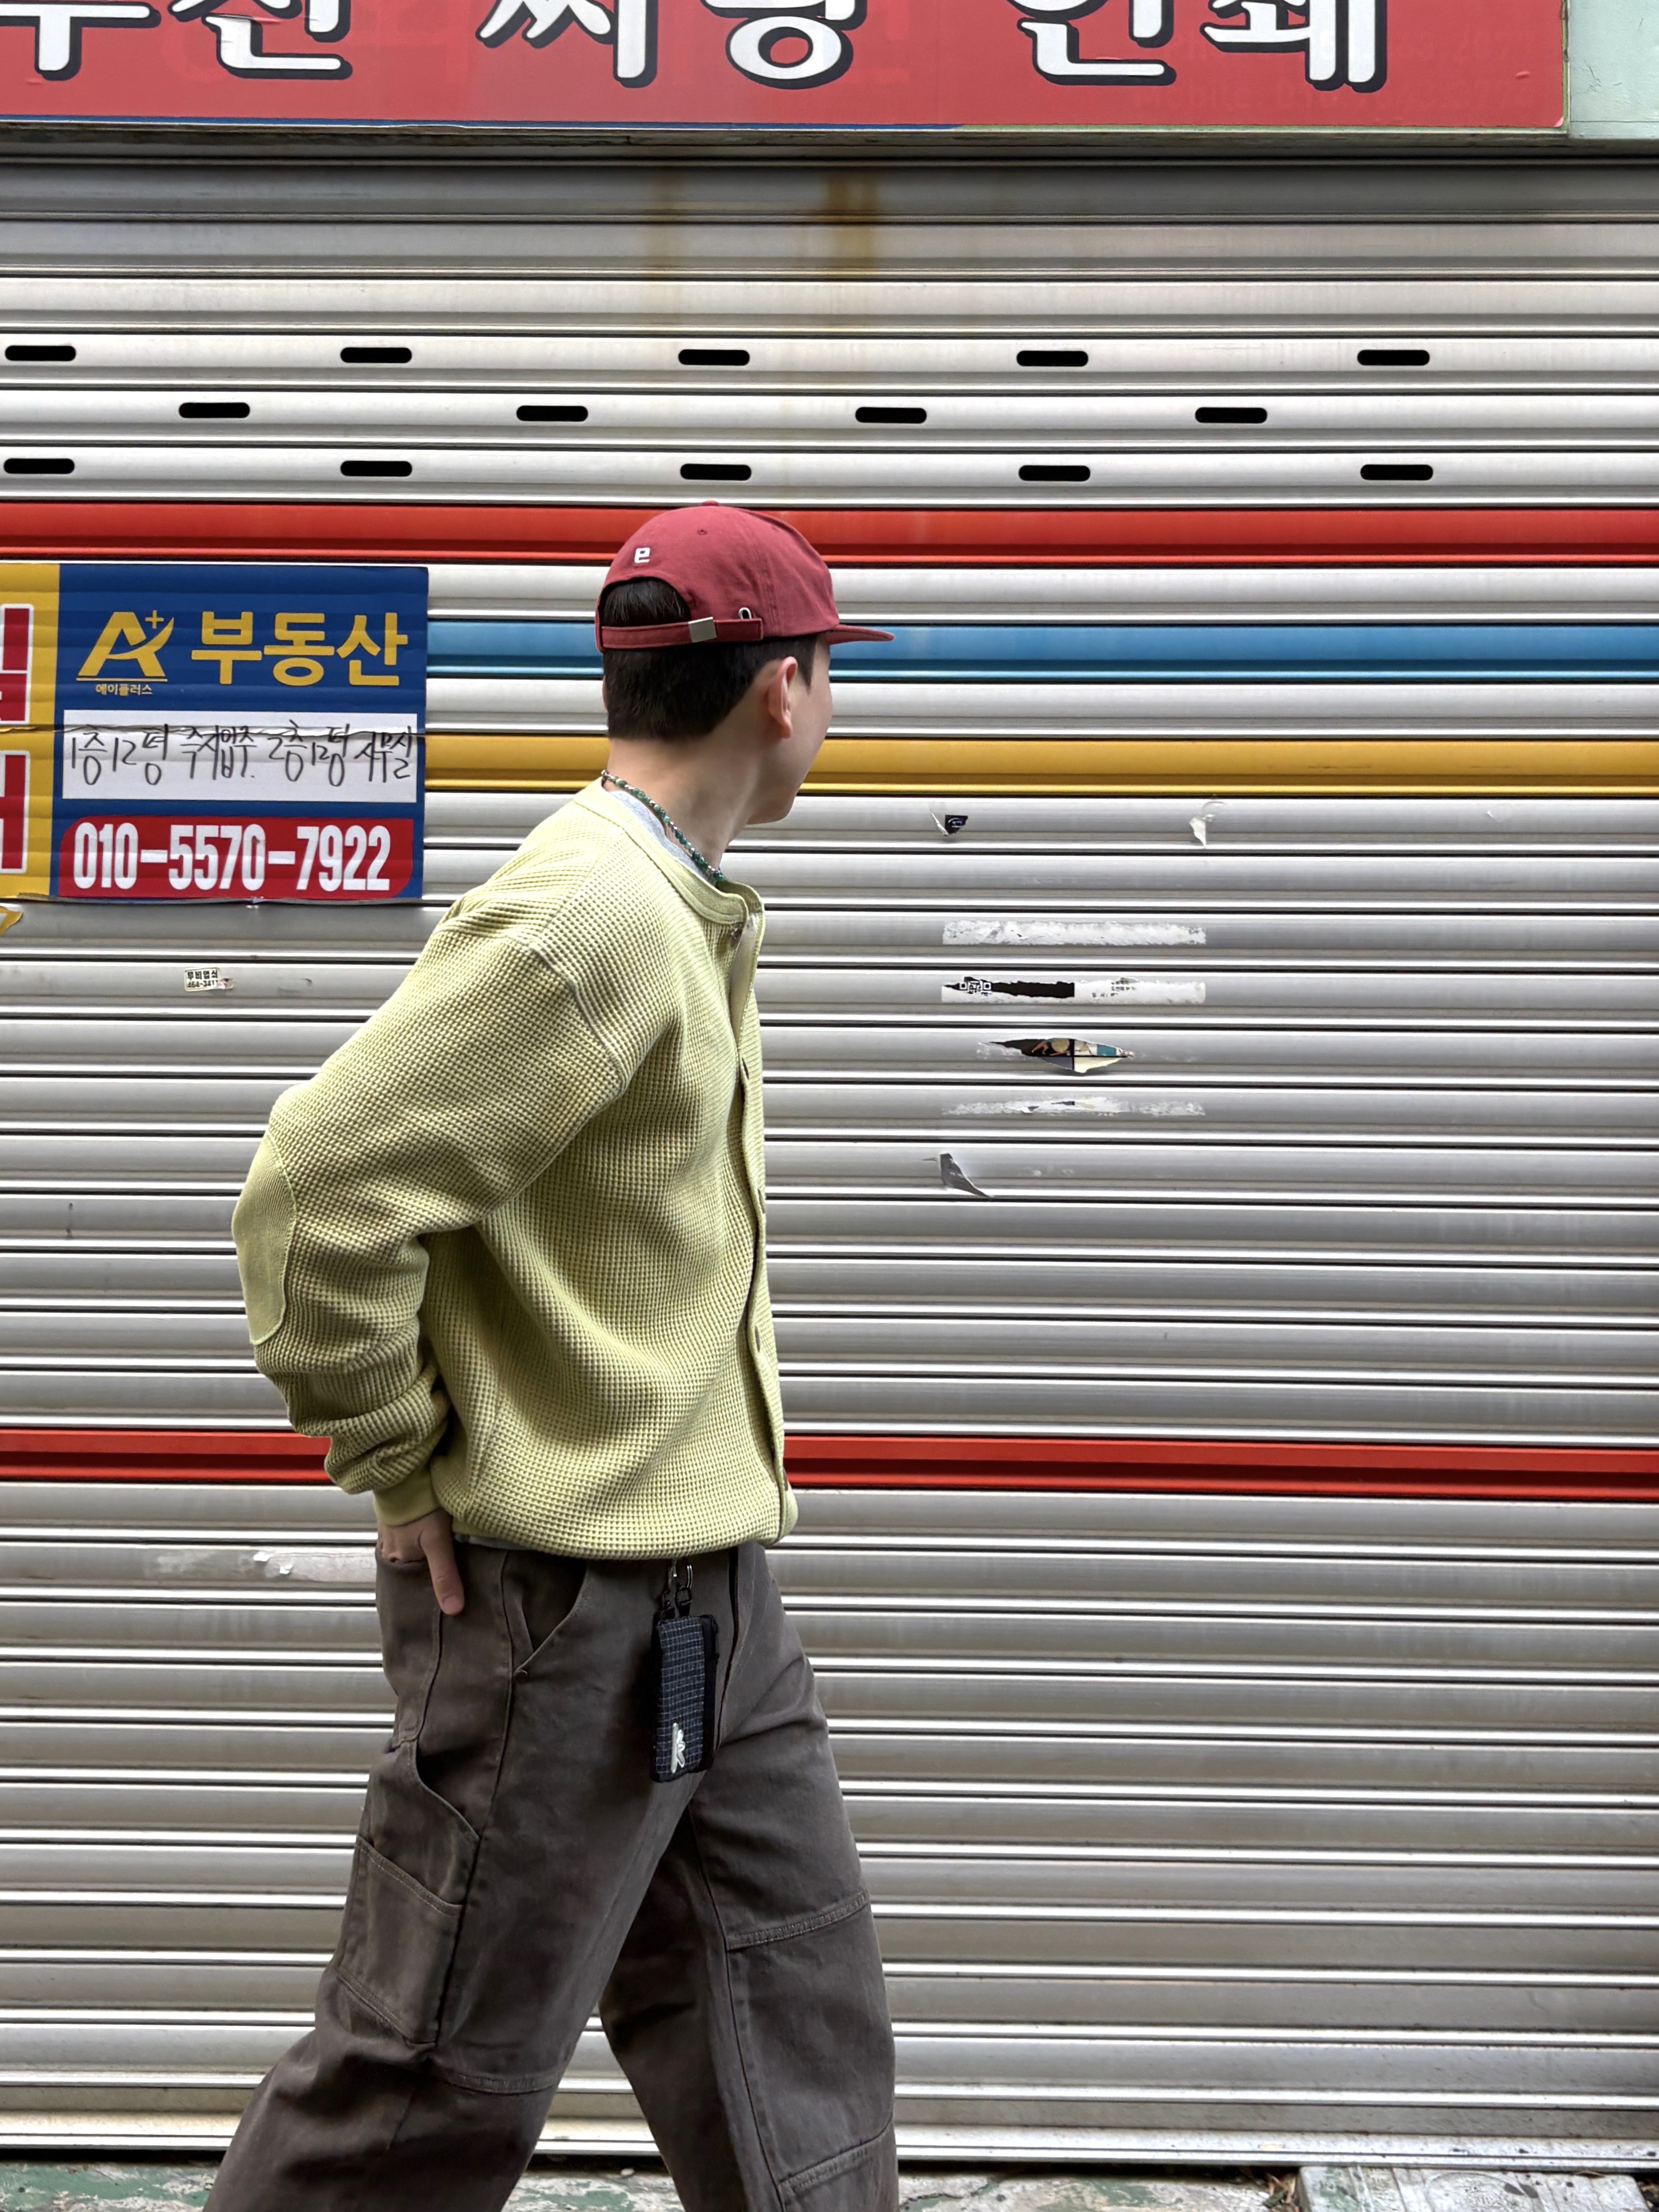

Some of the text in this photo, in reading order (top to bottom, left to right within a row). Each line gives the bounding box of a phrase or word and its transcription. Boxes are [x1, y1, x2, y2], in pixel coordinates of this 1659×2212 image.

[191, 611, 408, 686] 부동산
[95, 684, 153, 696] 에이플러스
[73, 822, 390, 892] 010-5570-7922
